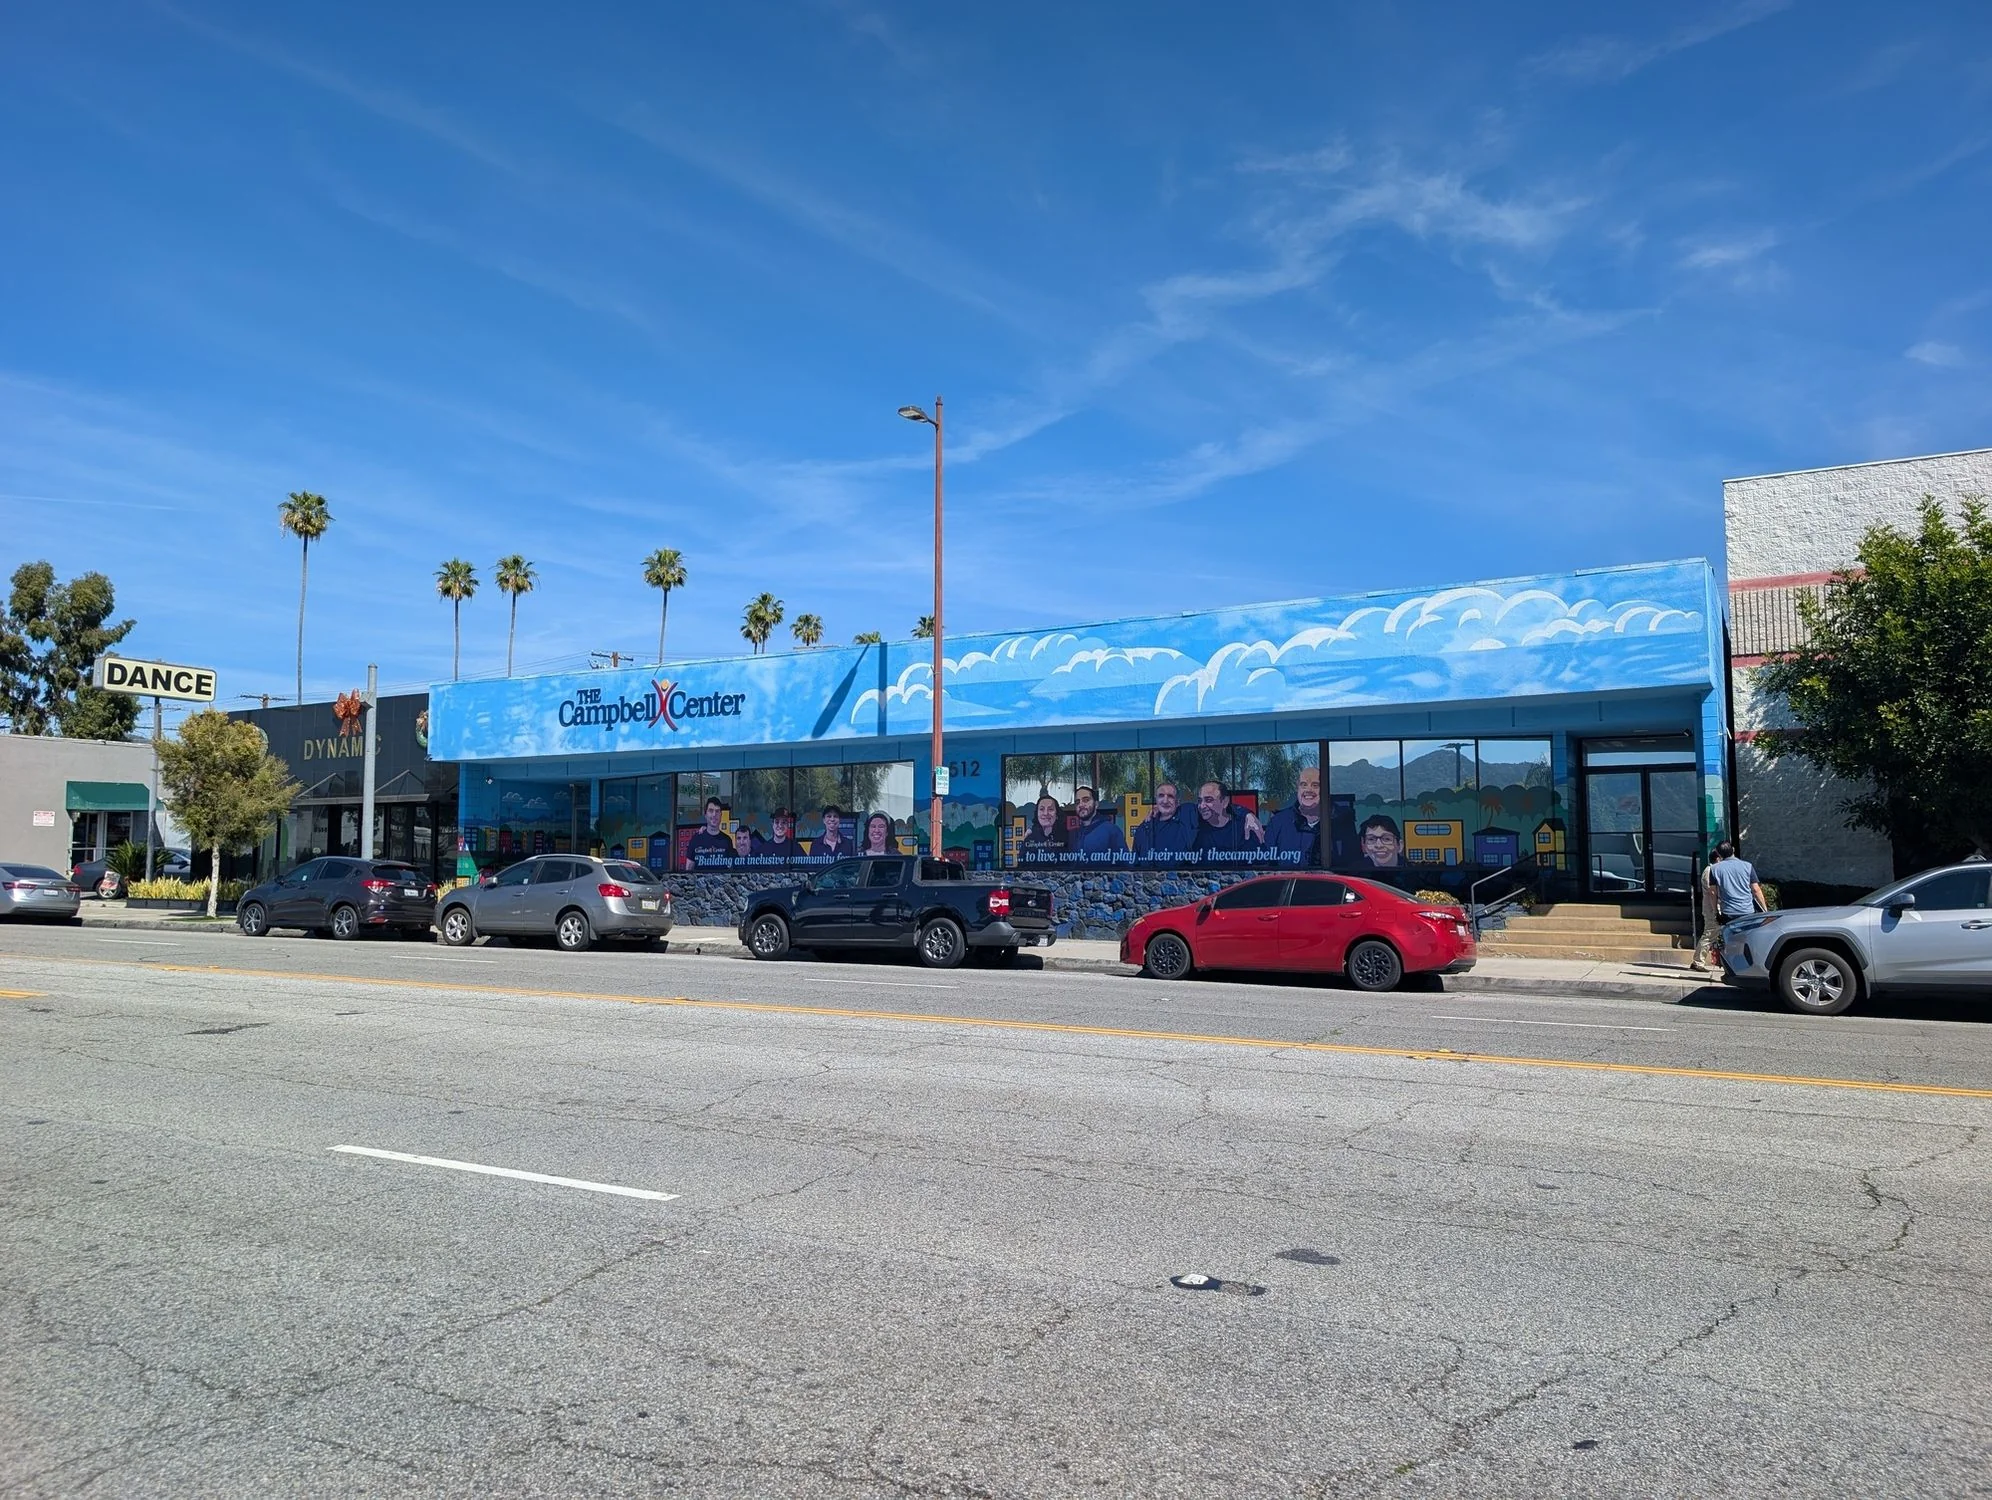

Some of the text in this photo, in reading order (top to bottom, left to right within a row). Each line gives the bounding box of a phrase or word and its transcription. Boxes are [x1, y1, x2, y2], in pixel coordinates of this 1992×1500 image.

[107, 663, 212, 696] DANCE
[577, 688, 601, 705] THE
[559, 691, 746, 731] Campbell Center
[304, 734, 382, 760] DYNAMC
[734, 856, 746, 865] an
[747, 853, 785, 866] inclusive
[786, 852, 835, 865] community
[1025, 851, 1036, 862] to
[1037, 849, 1058, 864] live,
[1060, 849, 1089, 864] work,
[1091, 848, 1112, 862] and
[1112, 848, 1136, 864] play
[1175, 848, 1204, 864] way!
[1207, 847, 1302, 864] thecampbell.org
